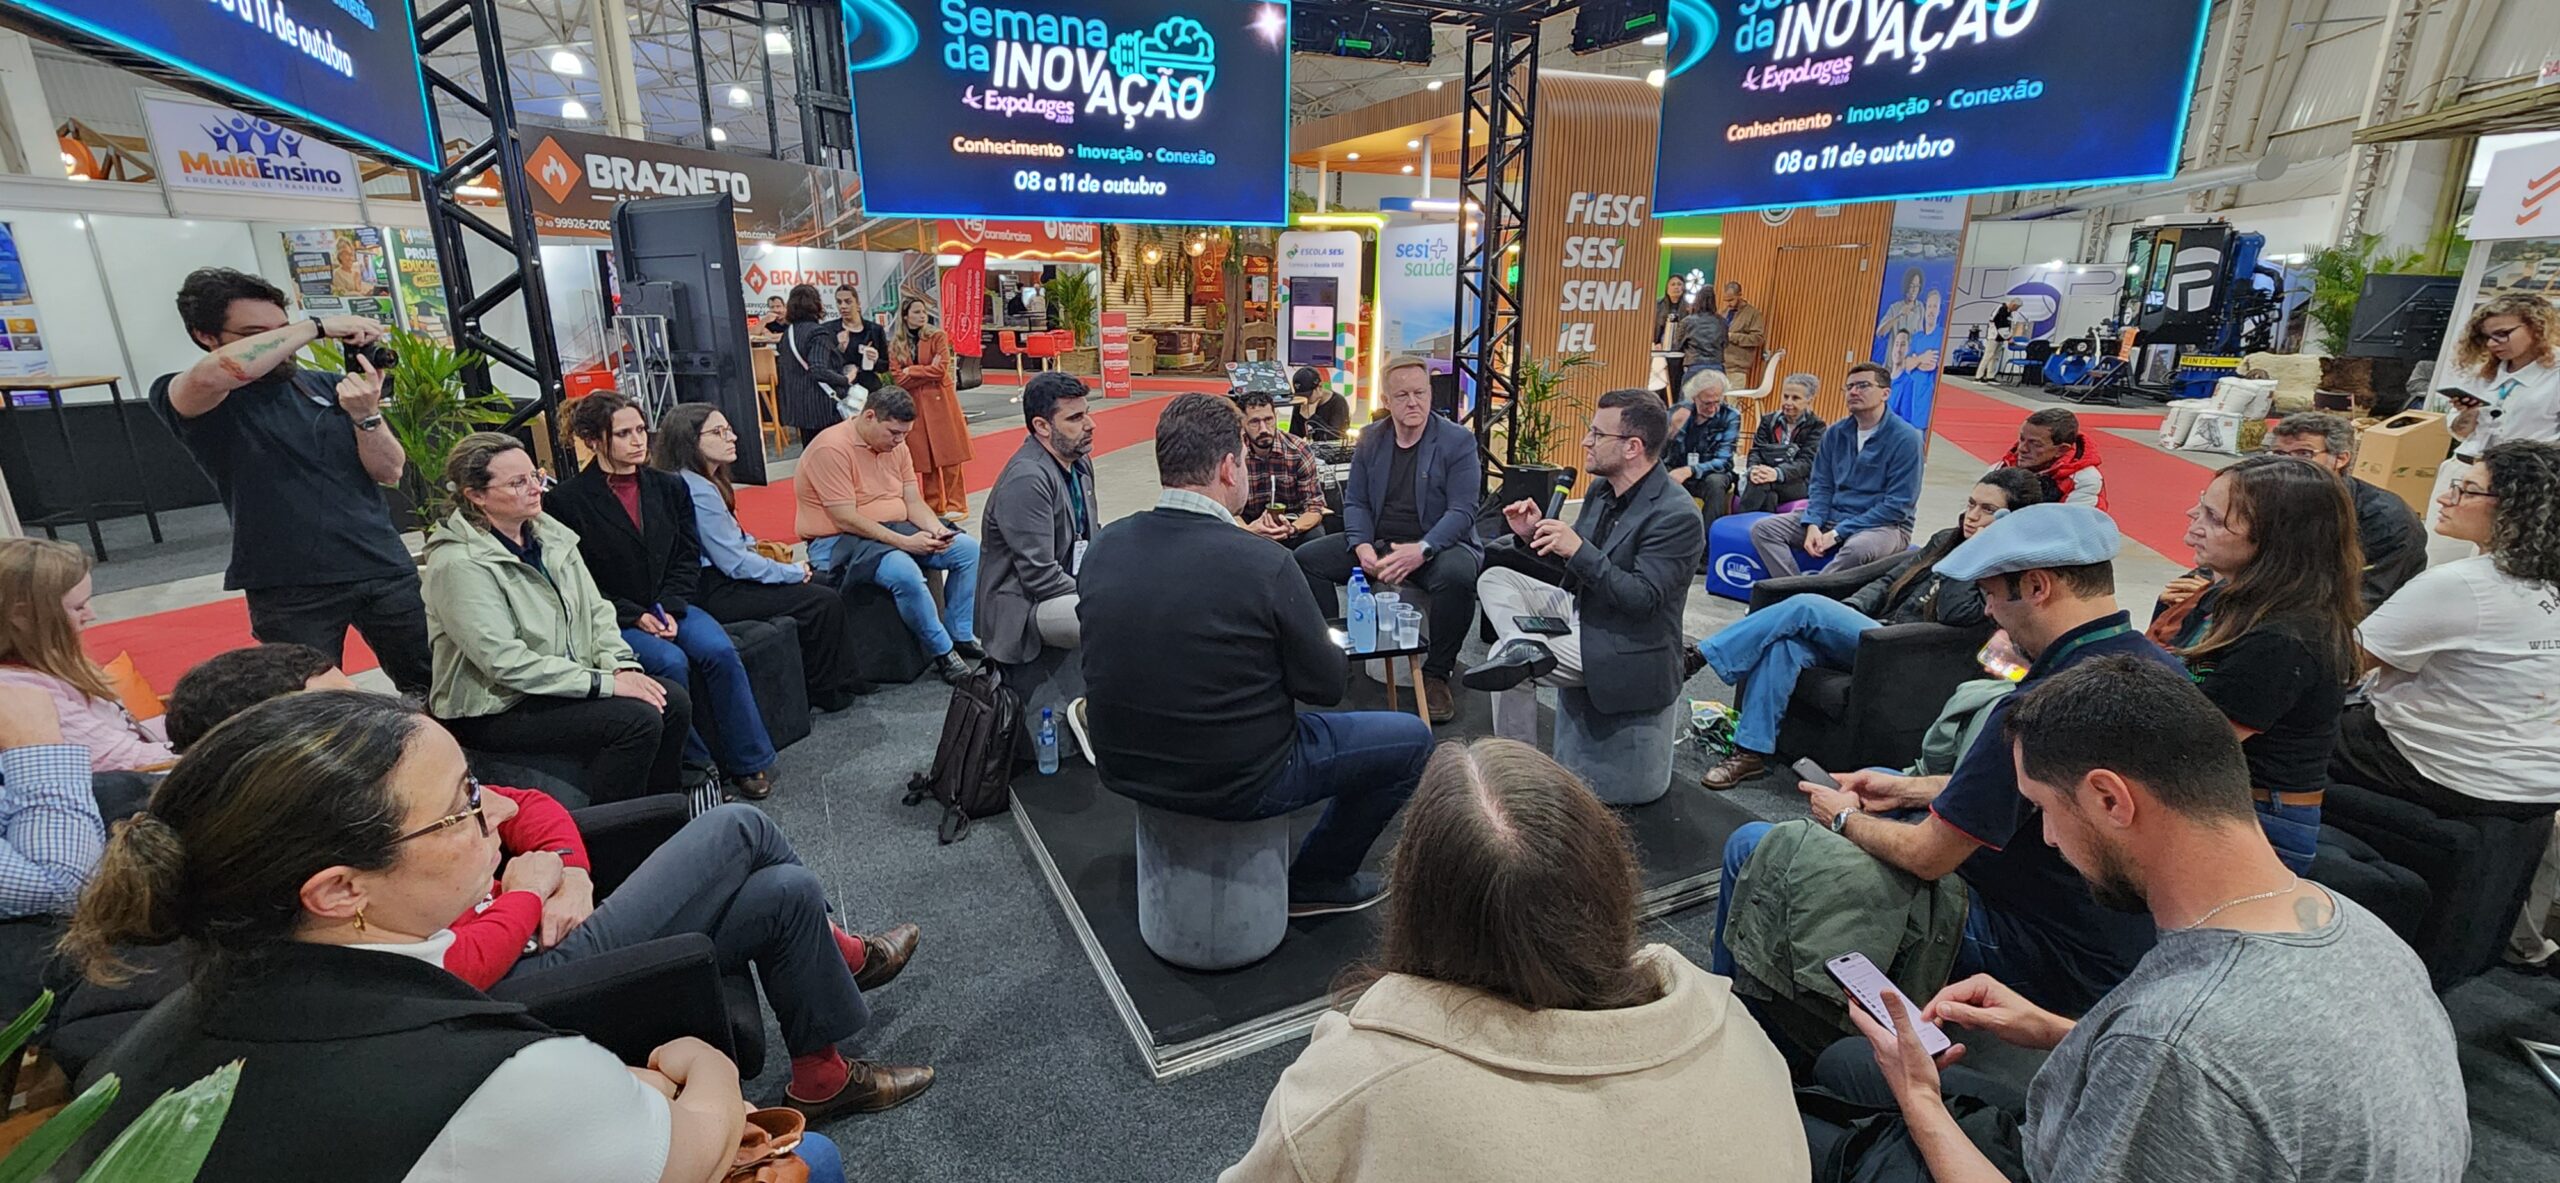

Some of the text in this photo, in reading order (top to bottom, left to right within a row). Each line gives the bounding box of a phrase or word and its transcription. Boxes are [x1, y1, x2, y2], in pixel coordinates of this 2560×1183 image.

[275, 0, 298, 47] de
[299, 25, 354, 77] outubro
[940, 0, 1109, 48] Semana
[1735, 14, 1775, 53] da
[944, 35, 1206, 129] da INOVAÇÃO
[1760, 55, 1854, 92] ExpoLages
[984, 89, 1075, 118] ExpoLages
[1727, 79, 2044, 142] Conhecimento Inovação Conexão
[178, 149, 342, 185] MultiEnsino
[953, 136, 1216, 165] Conhecimento Inovação Conexão
[1774, 134, 1955, 175] 08 a 11 de outubro
[185, 176, 246, 187] EDUCAÇÃO
[278, 183, 345, 193] TRANSFORMA
[585, 153, 752, 203] BRAZNETO
[1014, 171, 1167, 195] 08 a 11 de outubro
[1300, 247, 1327, 256] ESCOLA
[1404, 257, 1455, 277] saúde
[770, 270, 860, 287] BRAZNETO
